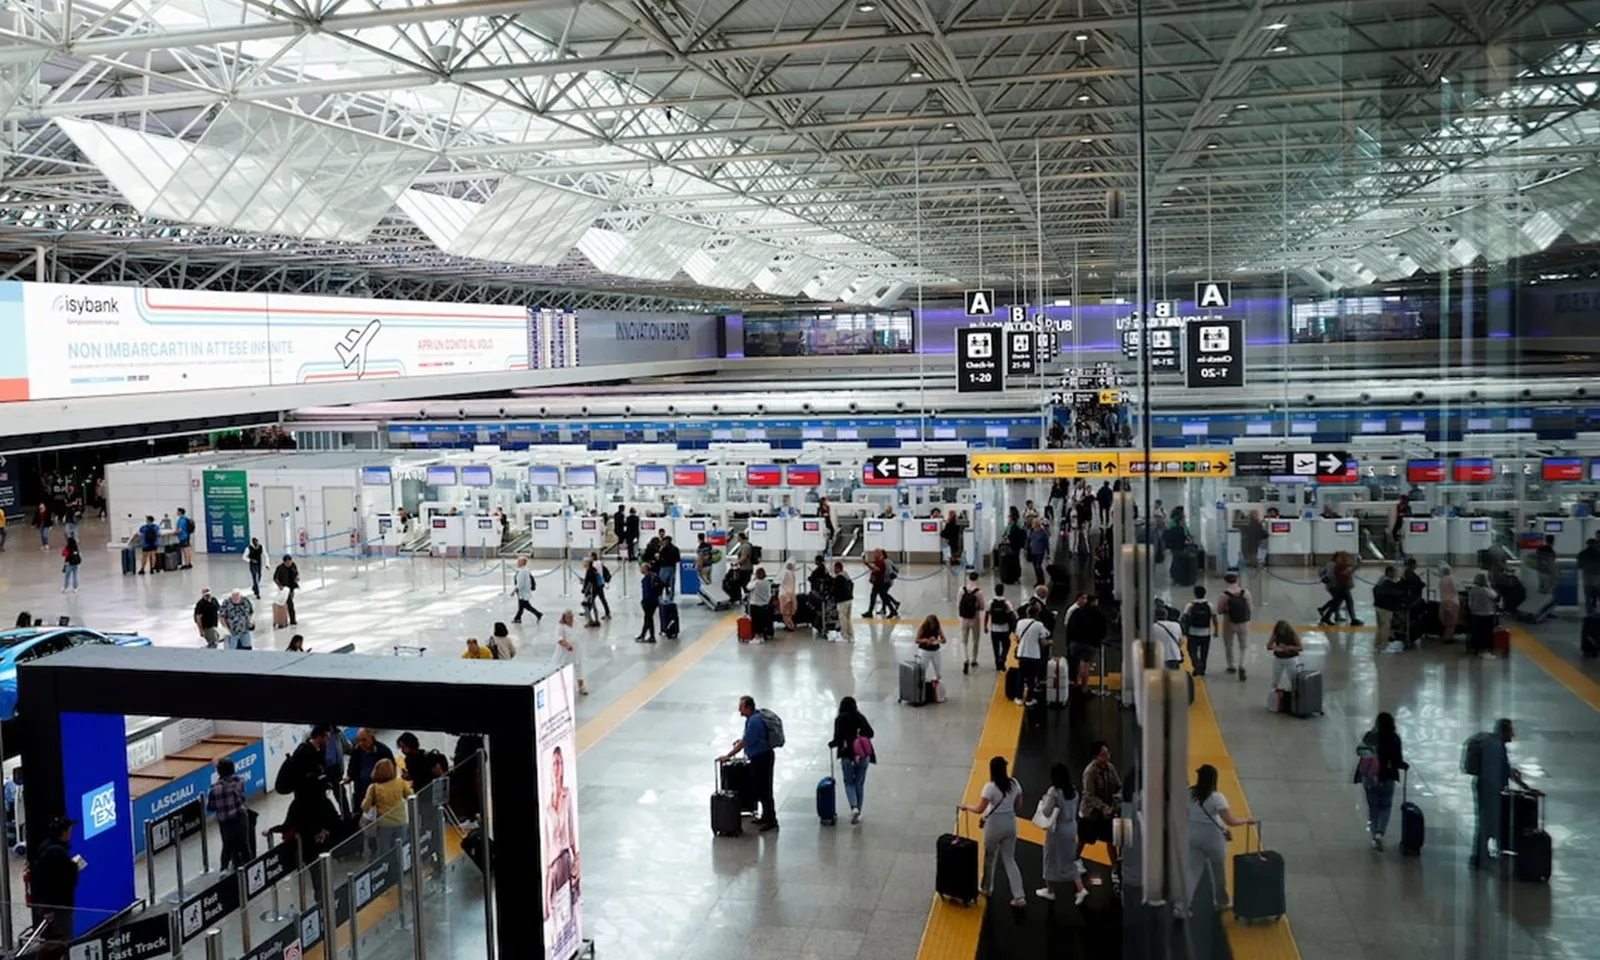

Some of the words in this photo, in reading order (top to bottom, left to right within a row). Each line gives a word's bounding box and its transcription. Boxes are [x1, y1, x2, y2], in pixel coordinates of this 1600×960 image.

[65, 294, 120, 315] isybank
[970, 292, 990, 314] A
[1013, 307, 1024, 322] B
[616, 321, 660, 341] INNOVATION
[68, 342, 102, 359] NON
[105, 341, 189, 358] IMBARCARTI
[191, 341, 203, 356] IN
[207, 341, 248, 356] ATTESE
[965, 361, 995, 369] Check-in
[969, 373, 992, 383] 1-20
[233, 753, 257, 773] KEEP
[151, 783, 194, 814] LASCIALI
[94, 801, 116, 828] EX
[107, 932, 131, 949] Self
[108, 947, 133, 960] Fast
[135, 936, 167, 955] Track
